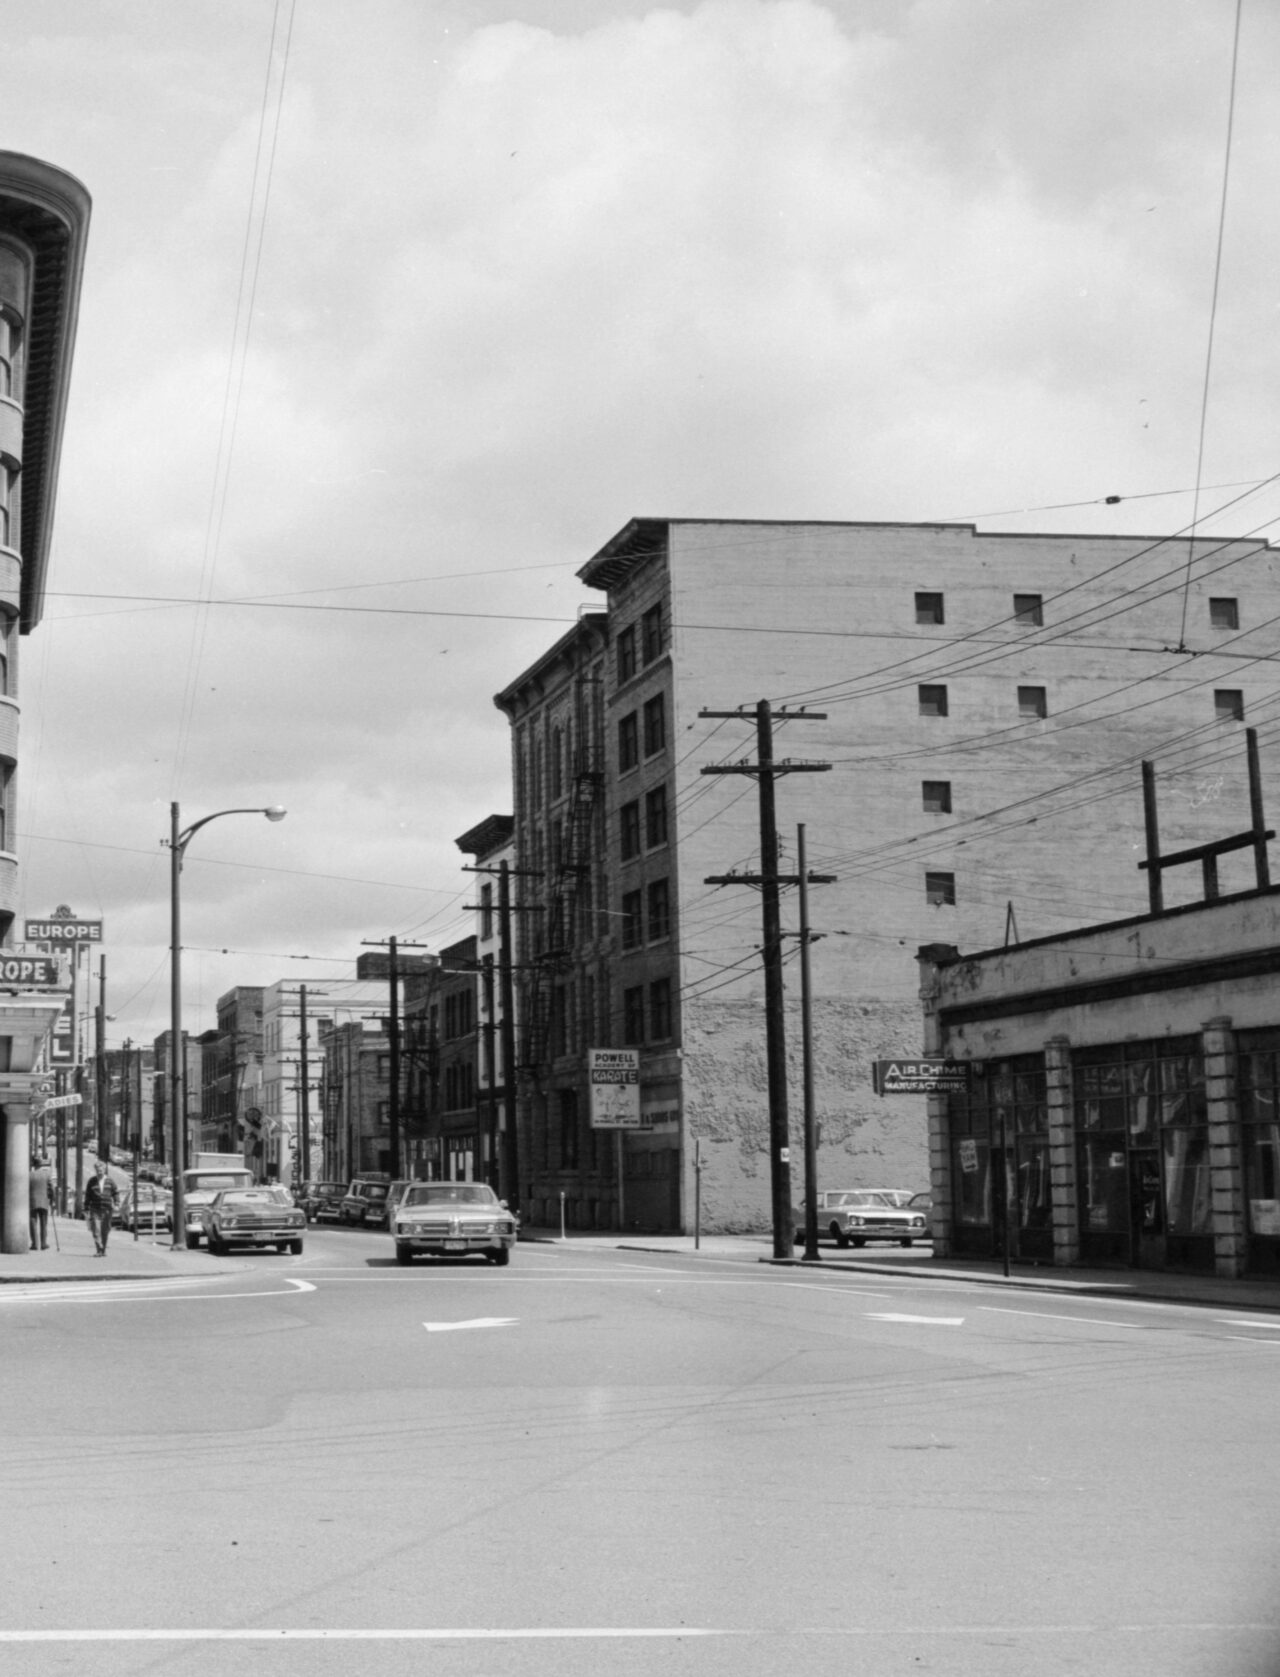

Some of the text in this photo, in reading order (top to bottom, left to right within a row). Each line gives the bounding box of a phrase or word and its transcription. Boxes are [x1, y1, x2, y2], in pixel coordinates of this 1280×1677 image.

[27, 924, 100, 939] EUROPE
[52, 947, 73, 1058] HEL
[595, 1053, 635, 1063] POWELL
[593, 1070, 637, 1083] KARATE
[884, 1081, 967, 1090] MANUFACTURING
[47, 1094, 80, 1108] ADIES
